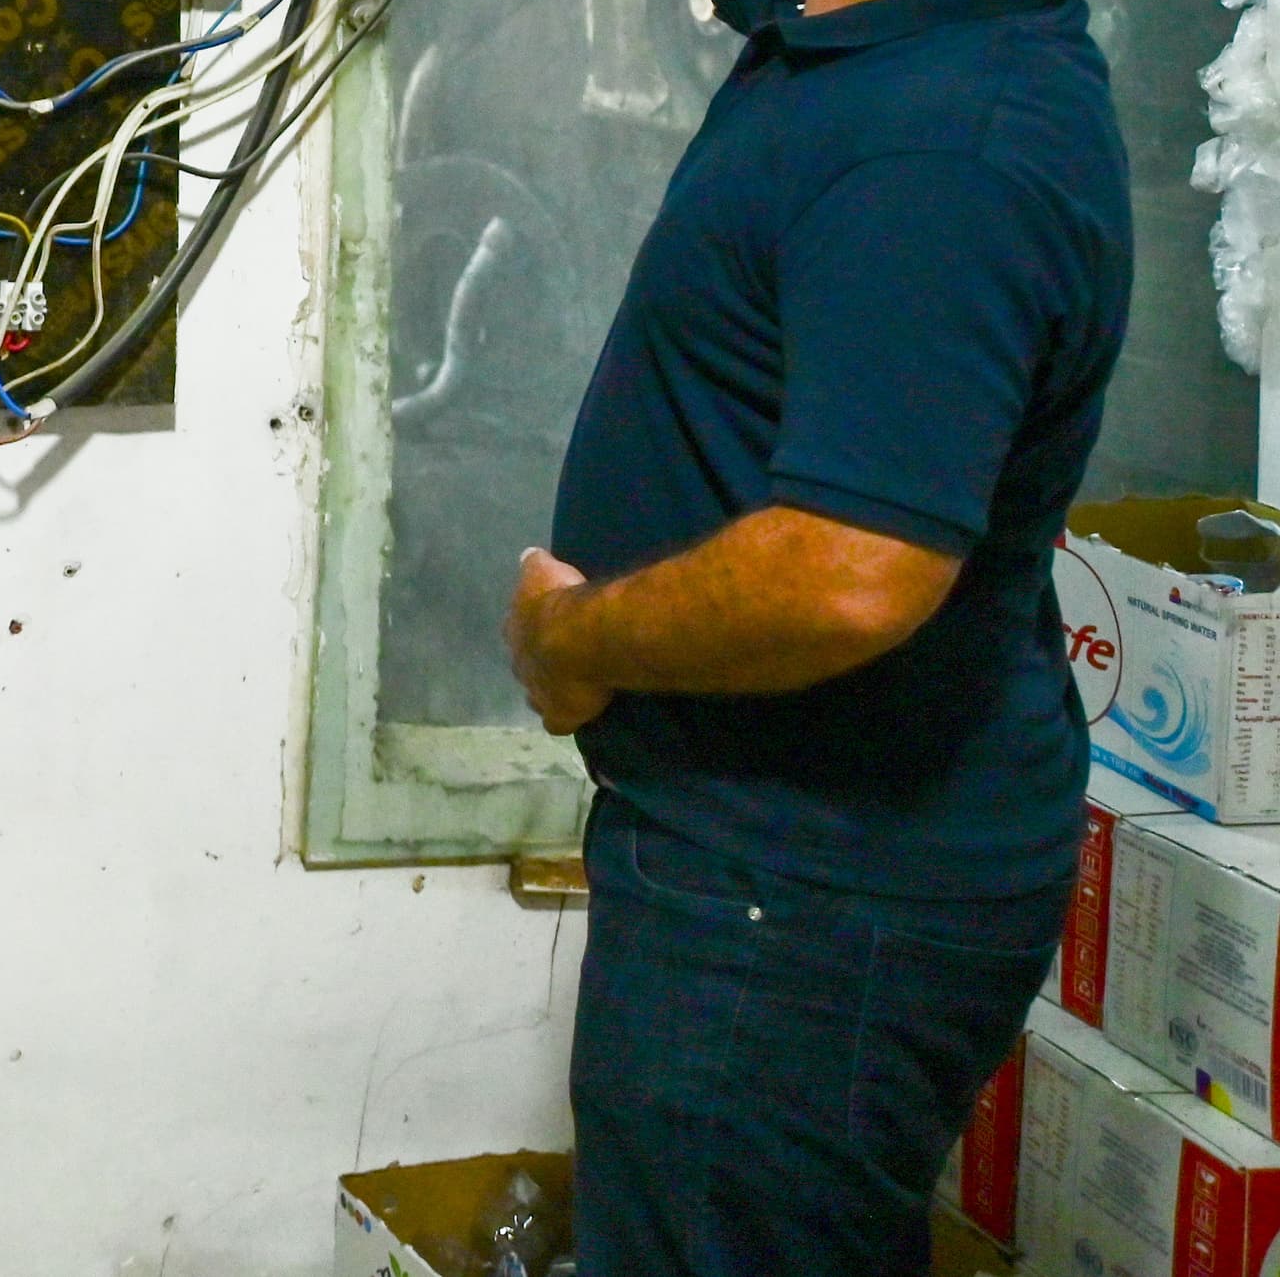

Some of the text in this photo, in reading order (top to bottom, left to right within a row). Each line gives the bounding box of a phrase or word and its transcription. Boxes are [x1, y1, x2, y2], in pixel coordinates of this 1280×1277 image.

[1127, 596, 1161, 618] NATURAL
[1161, 609, 1190, 630] SPRING
[1190, 621, 1218, 642] WATER
